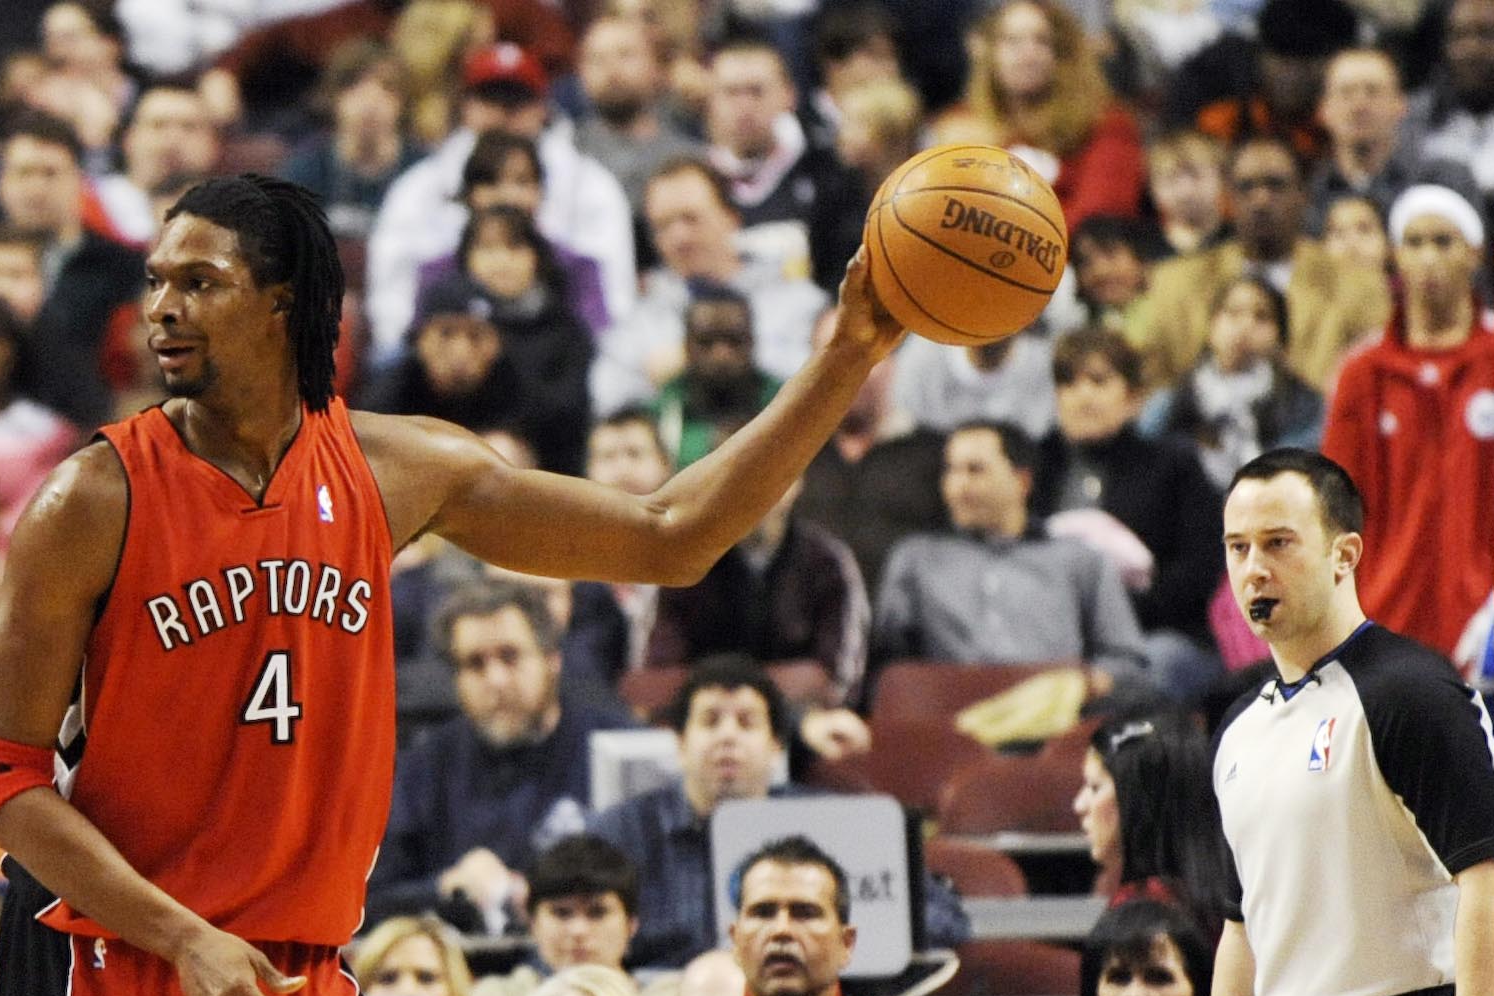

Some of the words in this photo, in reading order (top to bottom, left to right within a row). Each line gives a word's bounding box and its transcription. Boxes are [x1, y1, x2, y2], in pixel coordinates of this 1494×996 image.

[940, 198, 1061, 275] SPALDING
[146, 557, 374, 651] RAPTORS
[241, 650, 302, 745] 4
